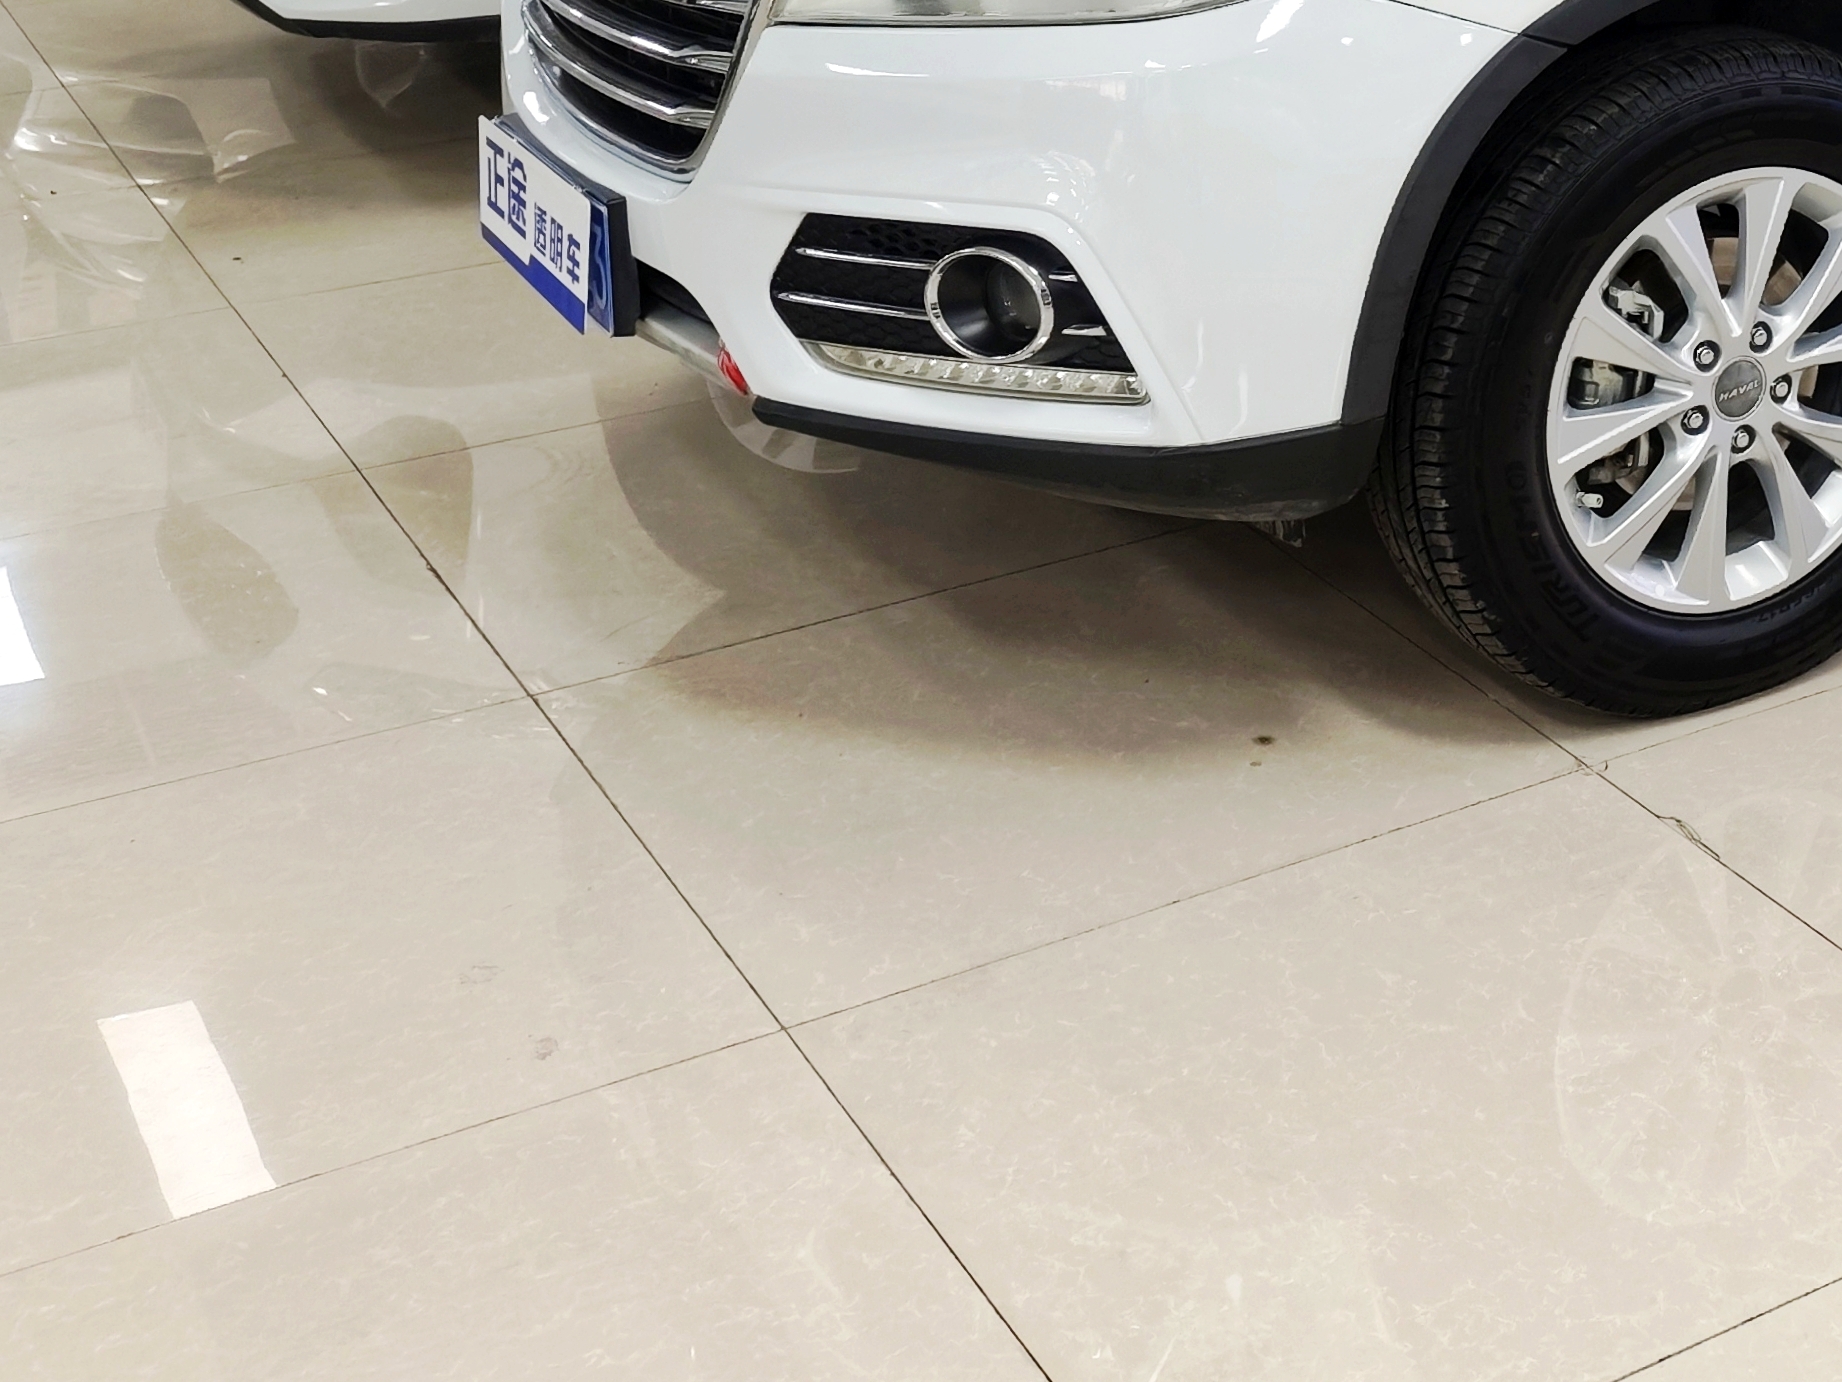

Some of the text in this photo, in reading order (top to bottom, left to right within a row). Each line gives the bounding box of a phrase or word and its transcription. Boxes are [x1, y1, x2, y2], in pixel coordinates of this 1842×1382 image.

[486, 135, 582, 285] 正途透明车
[1718, 379, 1761, 403] HAVAL
